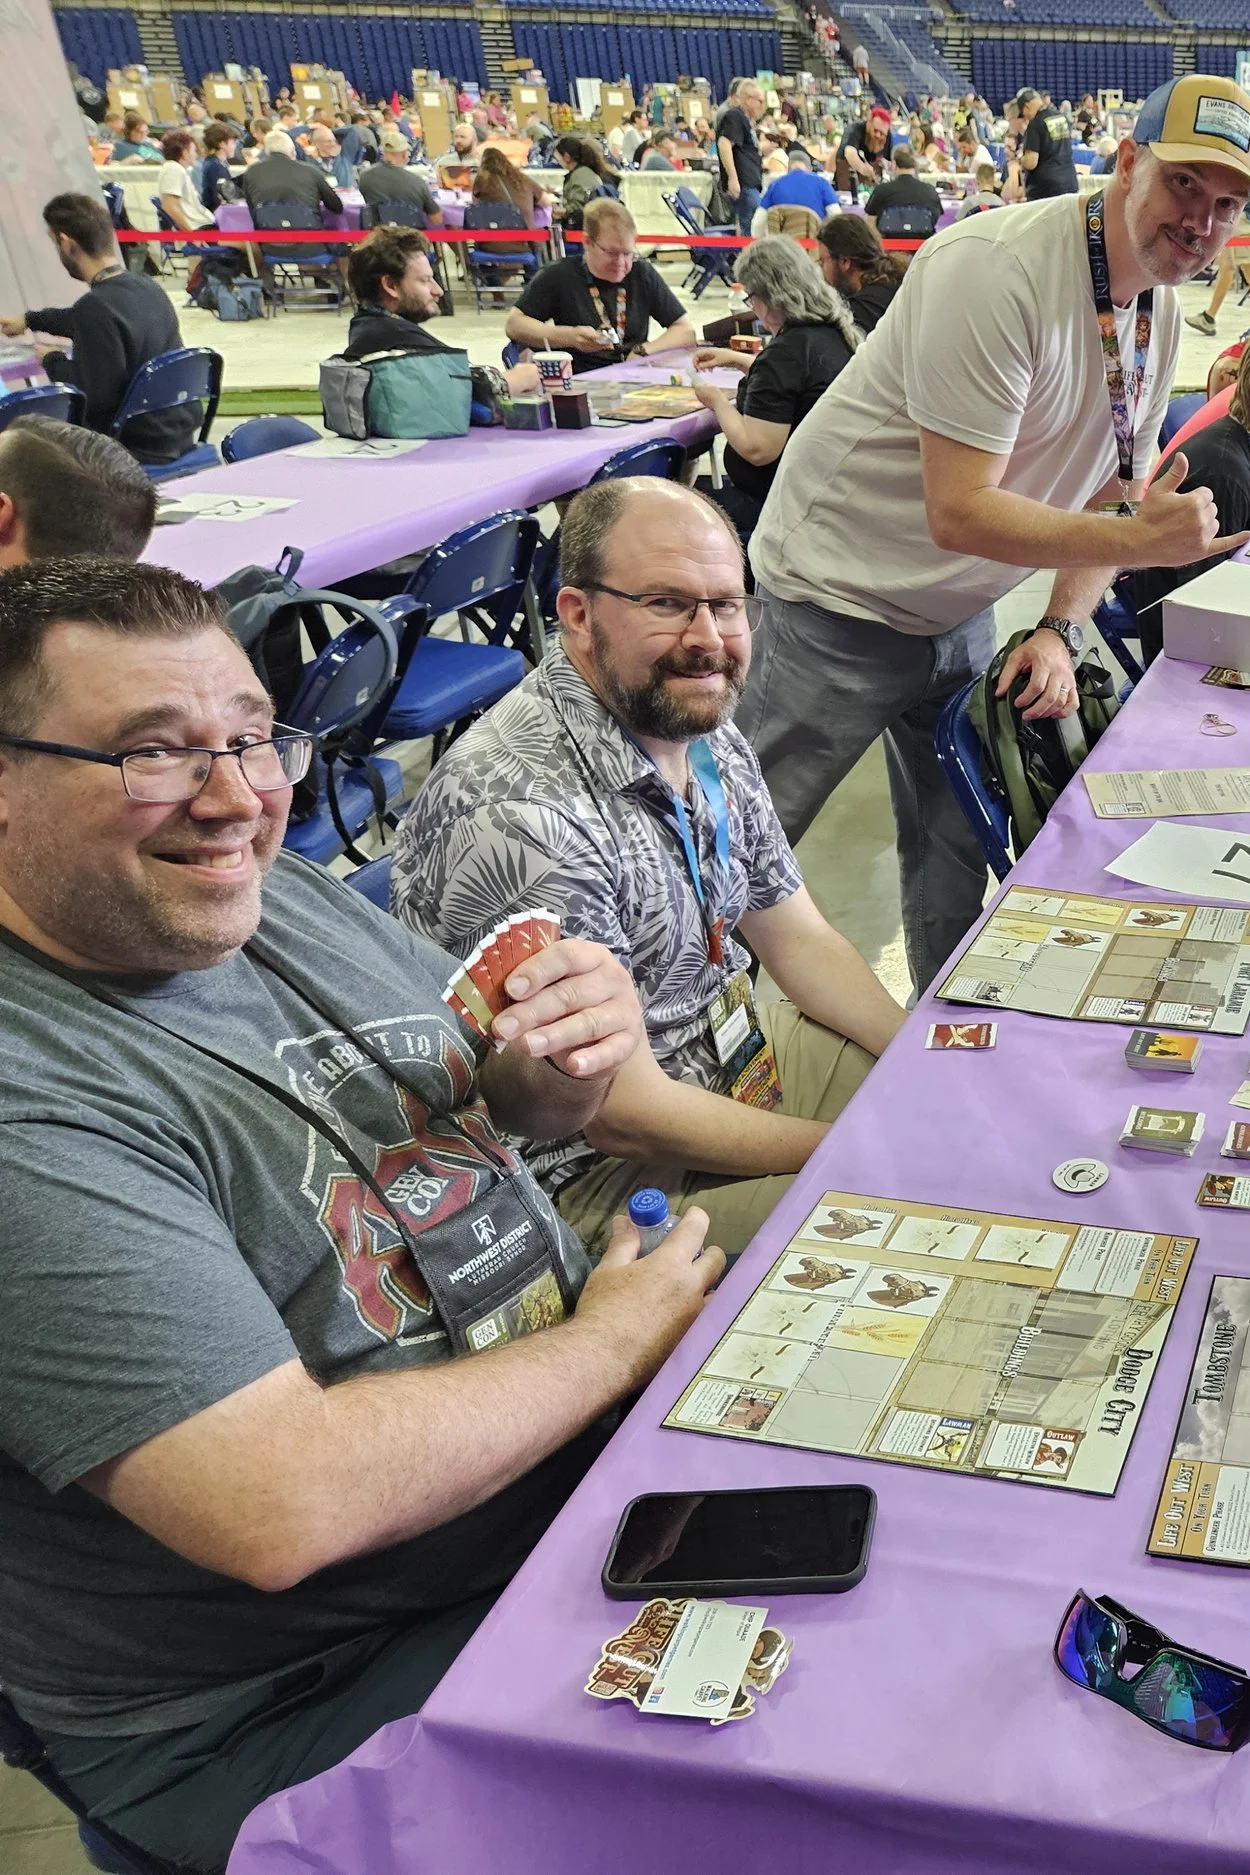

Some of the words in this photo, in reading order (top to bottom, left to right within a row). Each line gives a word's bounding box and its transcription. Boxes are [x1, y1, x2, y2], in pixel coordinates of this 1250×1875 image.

[1206, 100, 1226, 108] EVANS
[1089, 258, 1108, 300] RUSH
[317, 1032, 392, 1081] ABOT
[400, 1031, 432, 1058] TO
[448, 1242, 502, 1284] NORTHWEST
[499, 1220, 533, 1249] DISTRICT
[467, 1255, 502, 1282] LUTHERAN
[502, 1238, 527, 1258] CHURCH
[1173, 1239, 1191, 1258] LIFE
[473, 1260, 506, 1286] MISSOURI
[507, 1244, 527, 1262] SYNOD
[1166, 1258, 1185, 1276] OUT
[1156, 1277, 1179, 1301] WEST
[475, 1322, 495, 1340] GEN
[477, 1330, 496, 1347] CON
[1001, 1325, 1043, 1379] BUILDINGS
[1191, 1323, 1237, 1405] TOMBSTONE
[1112, 1347, 1155, 1394] DODGE
[941, 1418, 973, 1429] LAWMAN
[1098, 1398, 1136, 1437] CITY
[1046, 1429, 1075, 1441] OUTLAW
[1171, 1463, 1195, 1494] WEST
[1198, 1482, 1212, 1501] TURN
[1163, 1497, 1188, 1520] OUT
[1193, 1502, 1208, 1521] YOUR
[1212, 1500, 1225, 1523] PHASE
[1156, 1523, 1181, 1549] LIFE
[1190, 1522, 1203, 1534] ON
[1205, 1519, 1221, 1552] GUNSLINGER
[659, 1605, 696, 1681] www.walkingcarpetgames.com
